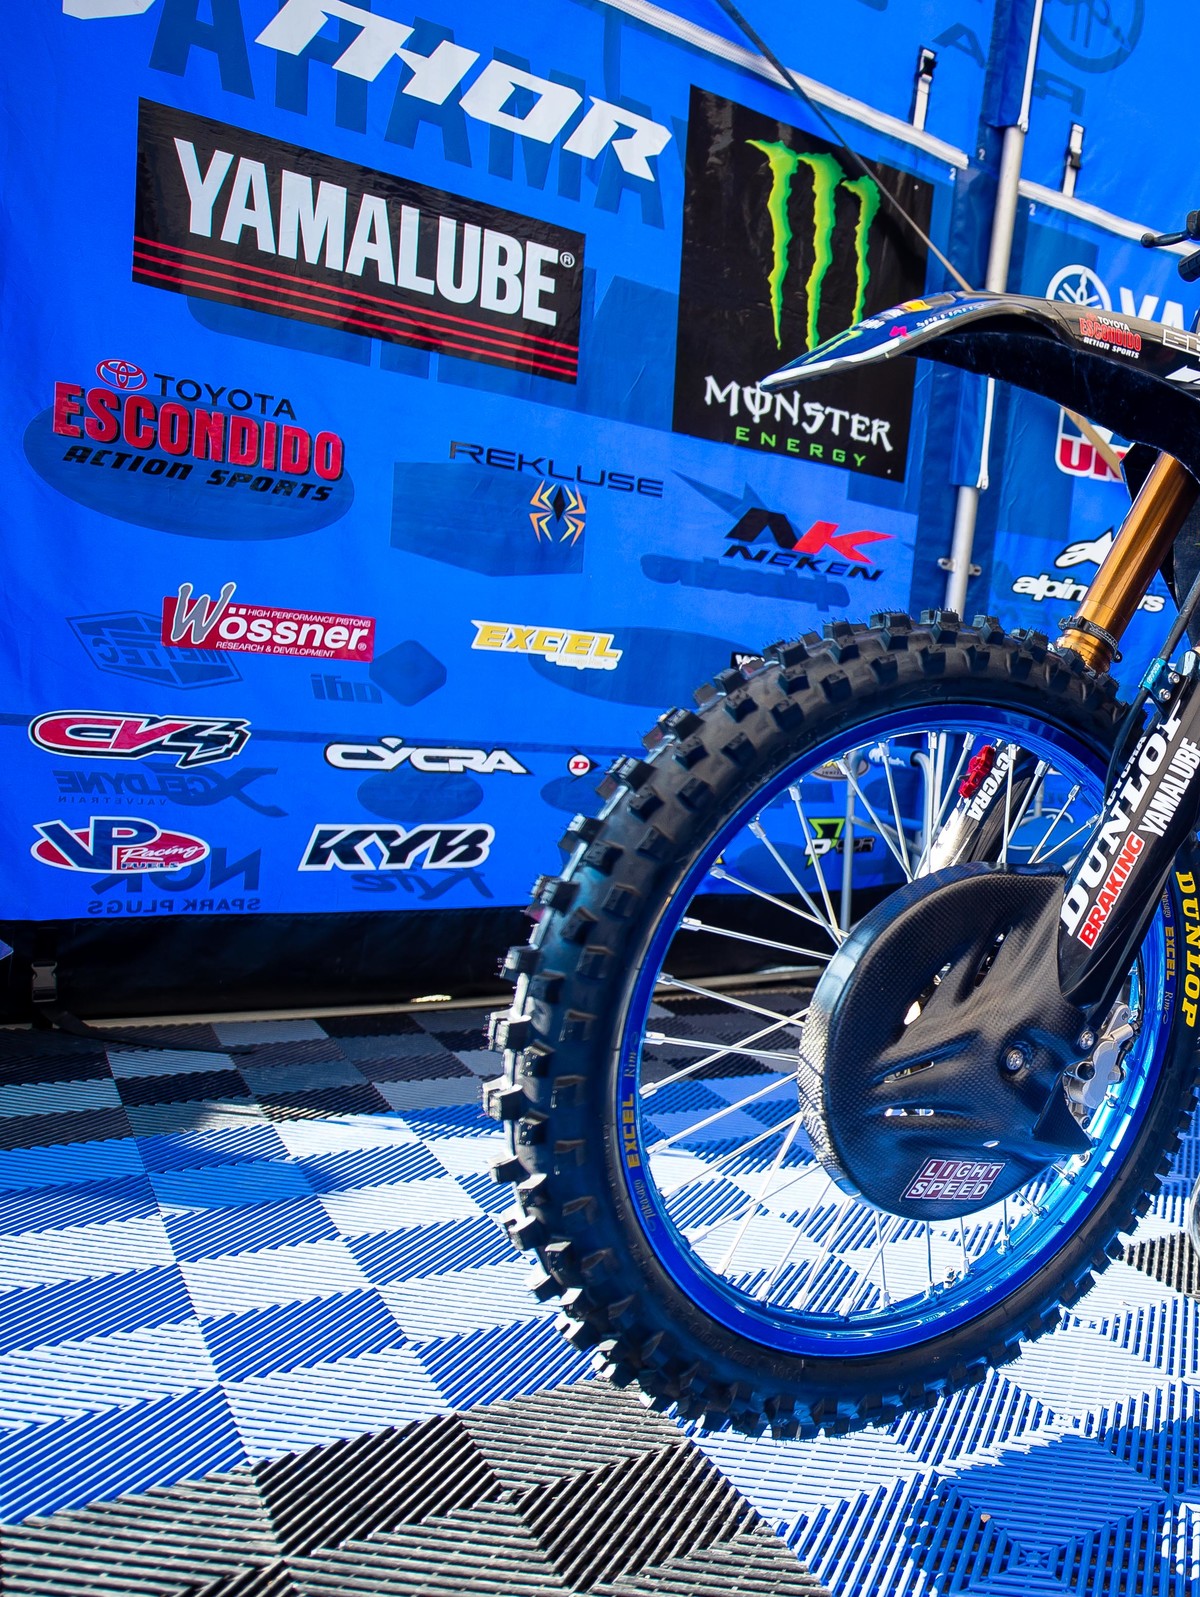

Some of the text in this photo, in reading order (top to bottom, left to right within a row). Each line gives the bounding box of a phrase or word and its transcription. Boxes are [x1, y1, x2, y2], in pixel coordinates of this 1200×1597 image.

[1079, 317, 1142, 351] ESCONDIDO
[1097, 315, 1130, 332] TOYOTA
[1083, 337, 1140, 359] ACTION SPORTS
[154, 373, 297, 421] TOYOTA
[52, 381, 344, 482] ESCONDIDO
[735, 426, 866, 467] ENERGY
[62, 444, 333, 501] ACTION SPORTS
[450, 441, 664, 499] REKLUSE
[724, 545, 885, 582] NEKEN
[247, 608, 371, 628] HIGH PERFORMANCE PISTONS
[215, 641, 264, 652] RESEARCH
[273, 646, 335, 658] DEVELOPMENT
[473, 623, 622, 660] EXCEL
[967, 751, 1011, 822] CYCRA
[33, 816, 161, 871] VP
[120, 845, 205, 861] Racing
[298, 823, 495, 871] KYB
[1077, 831, 1145, 950] BRAKING
[1165, 926, 1176, 981] EXCEL
[622, 1093, 641, 1168] EXCEL
[910, 1181, 989, 1196] SPEED
[924, 1162, 1002, 1178] LIGHT
